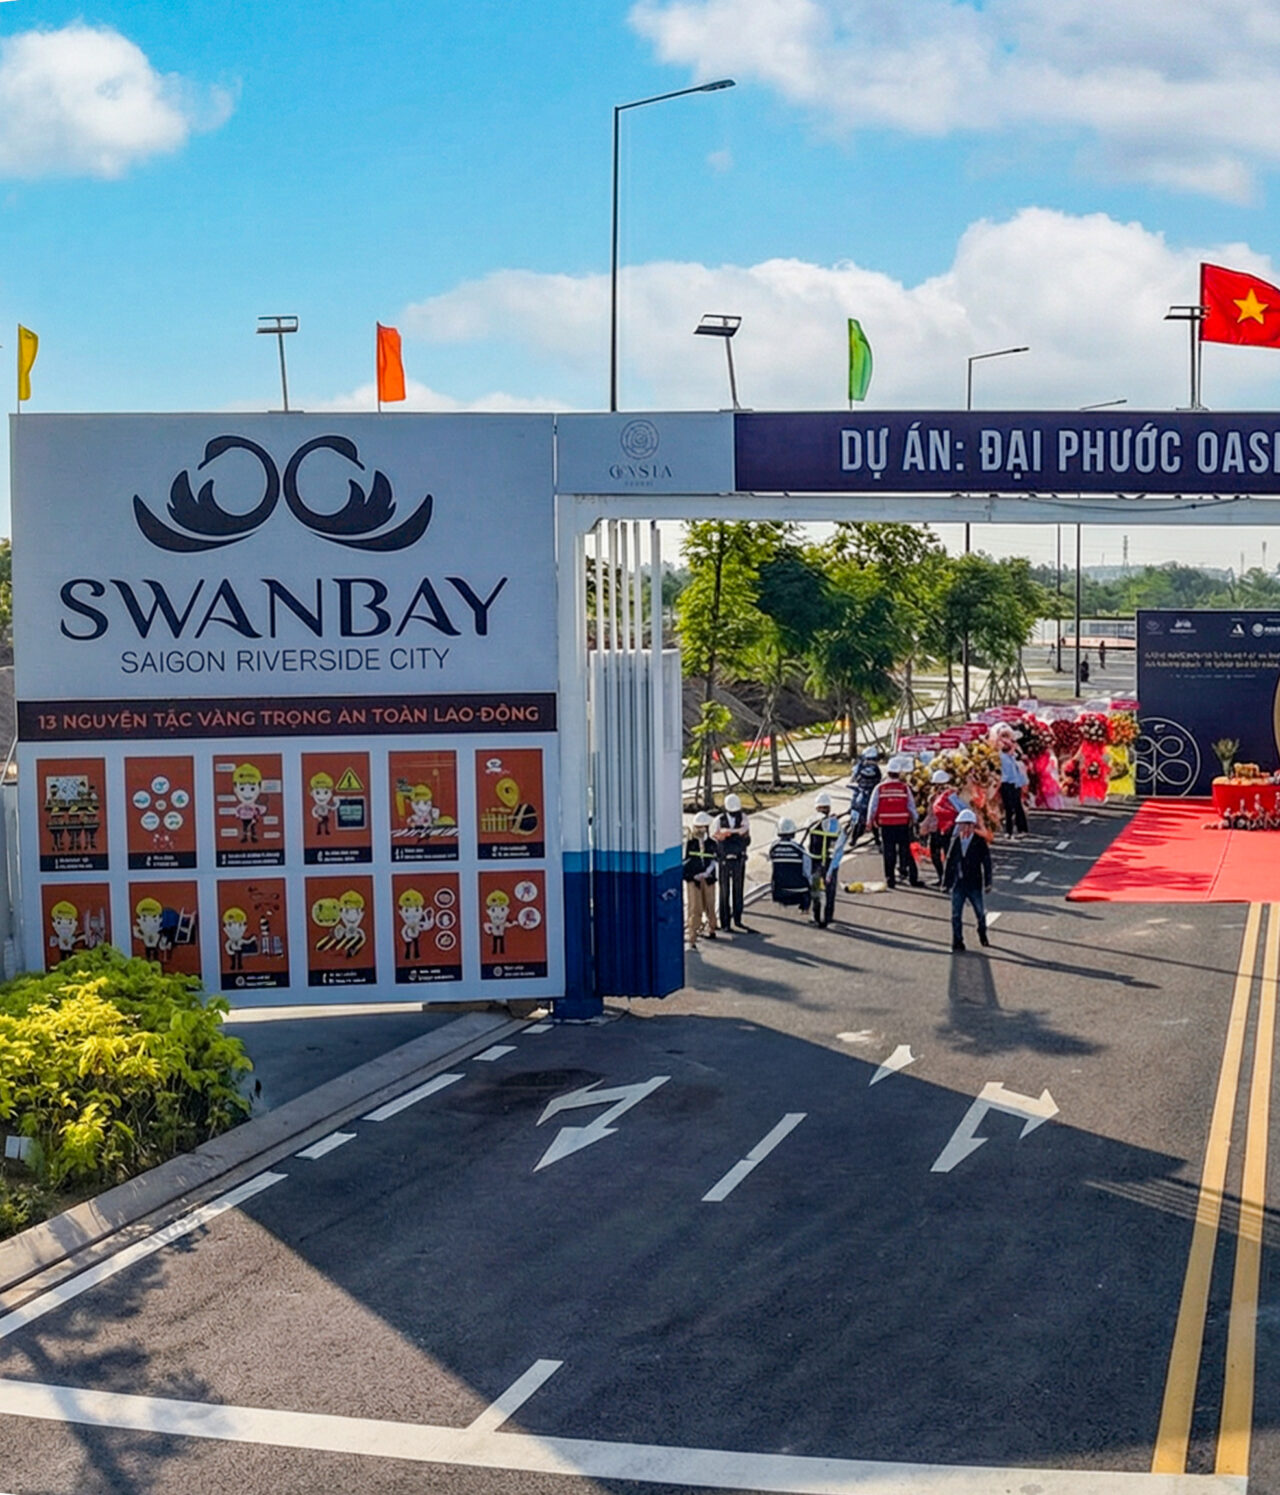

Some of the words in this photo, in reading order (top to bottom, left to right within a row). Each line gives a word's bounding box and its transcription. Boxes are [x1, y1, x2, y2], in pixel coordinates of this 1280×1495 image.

[841, 427, 889, 479] DỰ
[903, 421, 965, 471] ÁN:
[980, 429, 1041, 479] ĐẠI
[1059, 423, 1181, 473] PHƯỚC
[59, 576, 508, 641] SWANBAY
[120, 650, 225, 675] SAIGON
[236, 648, 382, 672] RIVERSIDE
[389, 647, 451, 670] CITY
[38, 714, 57, 729] 13
[197, 707, 256, 727] VÀNG
[260, 709, 332, 729] TRỌNG
[372, 705, 428, 725] TOÀN
